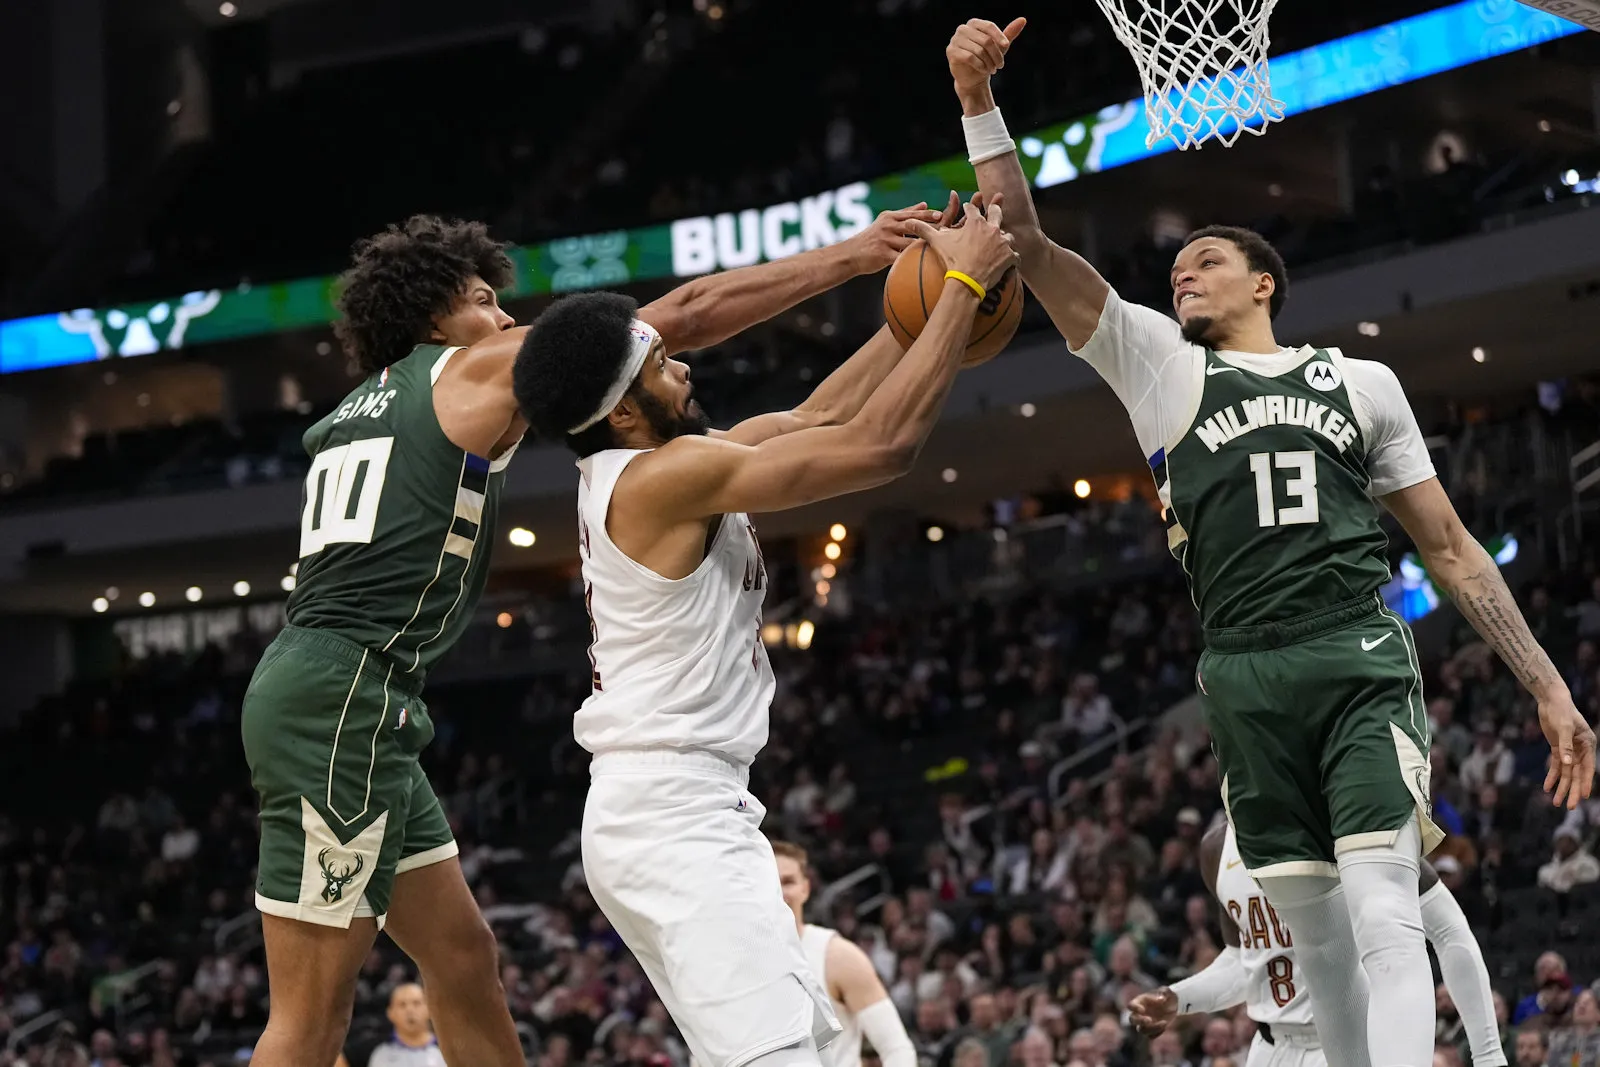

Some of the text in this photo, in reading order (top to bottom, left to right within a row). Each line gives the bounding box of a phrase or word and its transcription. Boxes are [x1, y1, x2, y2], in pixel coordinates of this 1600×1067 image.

[671, 181, 872, 277] BUCKS
[333, 390, 396, 424] SIMS
[1194, 395, 1358, 453] MILWAUKEE
[299, 437, 394, 558] 00
[1249, 451, 1319, 527] 13
[1267, 956, 1296, 1008] 8
